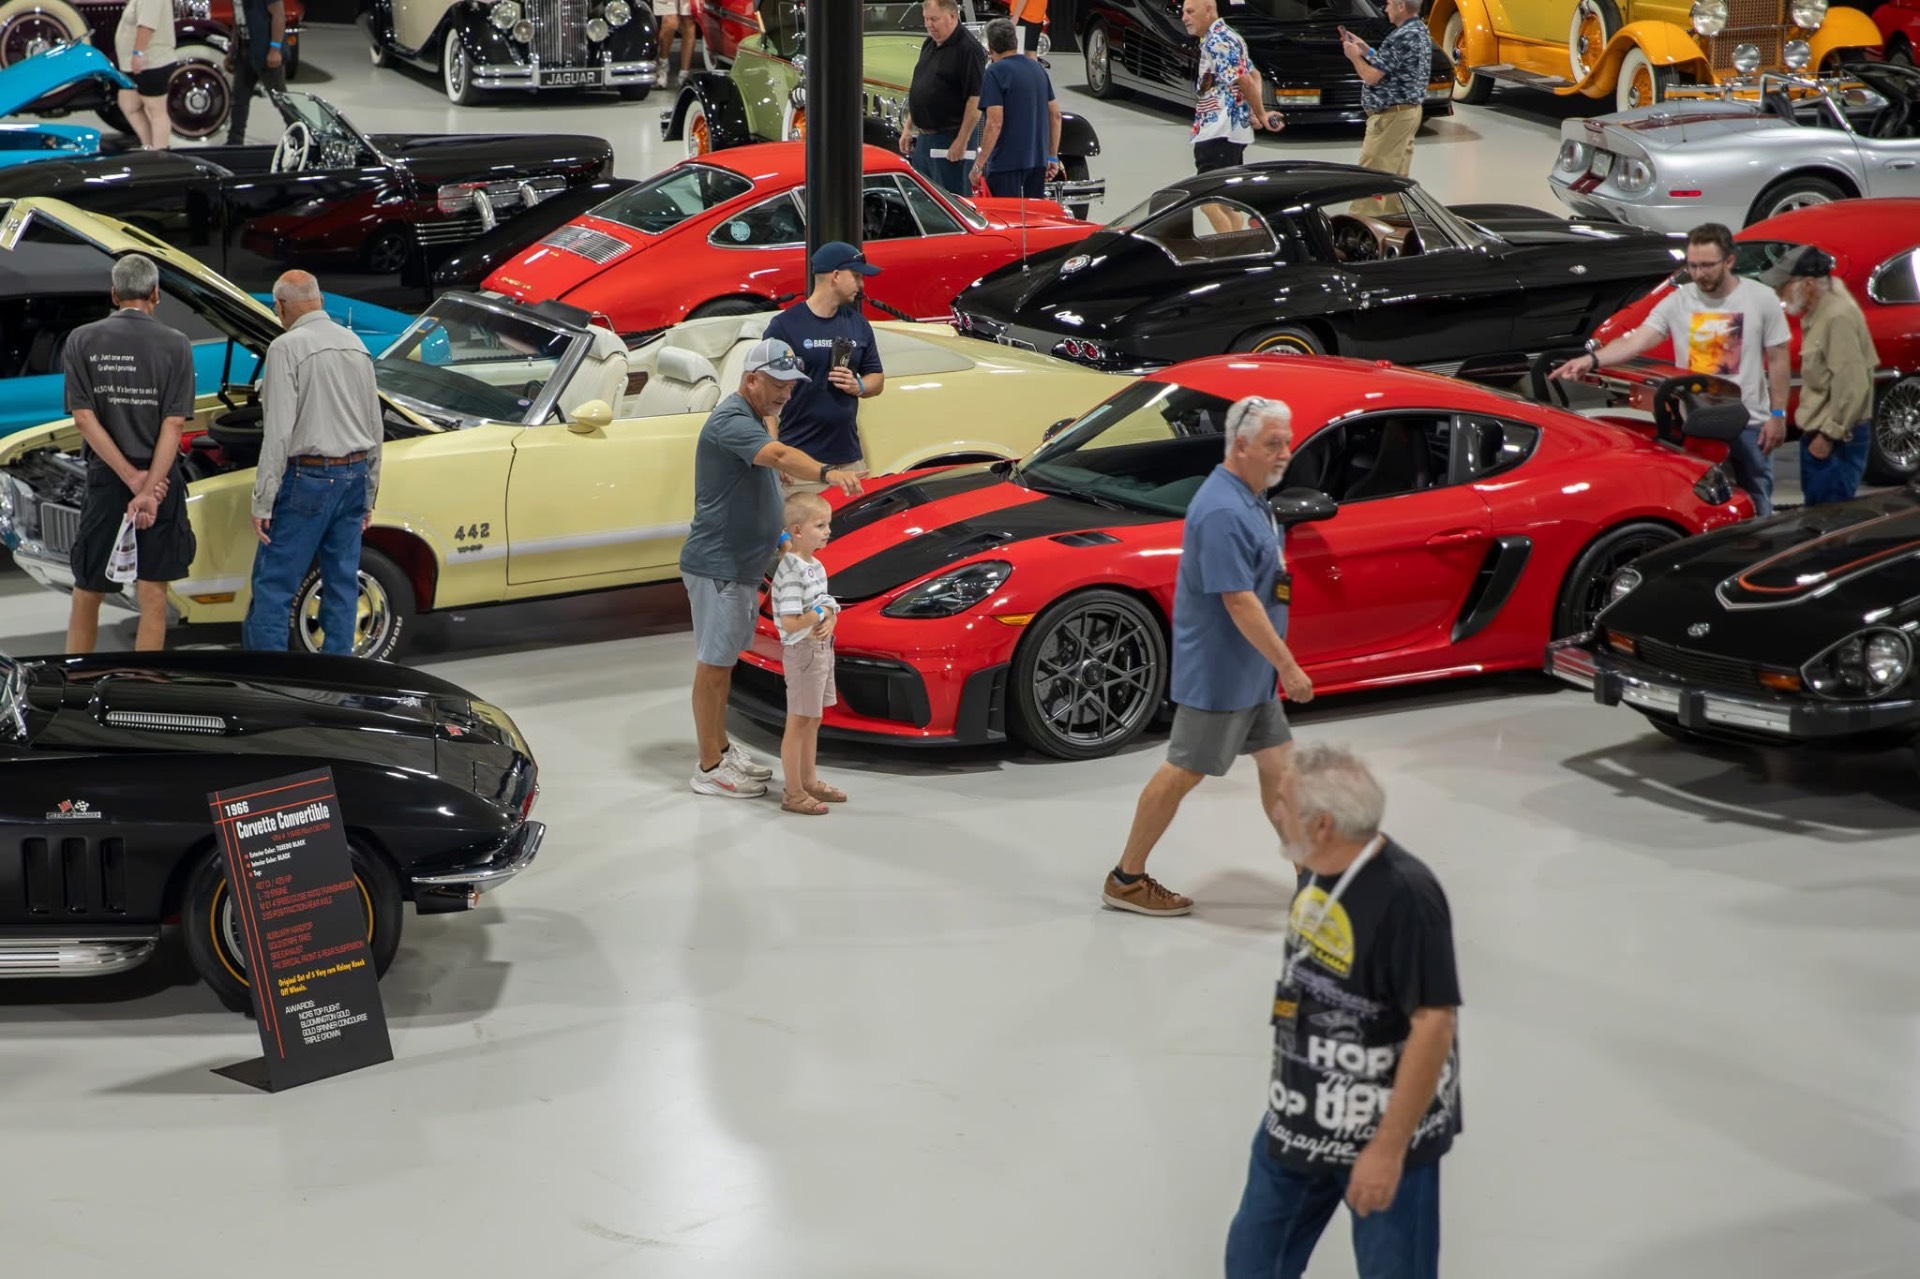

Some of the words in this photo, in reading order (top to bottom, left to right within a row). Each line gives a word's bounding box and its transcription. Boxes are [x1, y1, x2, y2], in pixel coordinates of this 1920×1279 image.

[547, 72, 595, 85] JAGUAR
[454, 522, 490, 541] 442
[225, 801, 249, 817] 1966
[236, 817, 277, 839] Corvette
[277, 803, 329, 829] Convertible
[264, 847, 276, 855] Color:
[276, 842, 292, 851] TUXEDO
[292, 839, 306, 847] BLACK
[265, 856, 277, 864] Color:
[277, 852, 291, 861] BLACK
[278, 976, 296, 987] Original
[296, 974, 305, 982] Set
[306, 971, 312, 980] of
[315, 969, 326, 977] Very
[351, 958, 365, 968] Knock
[280, 987, 289, 996] Off
[285, 1000, 315, 1014] AWARDS:
[313, 1007, 323, 1016] TOP
[323, 1003, 340, 1013] FLIGHT
[300, 1013, 337, 1028] BLOOMINGTON
[336, 1009, 350, 1019] GOLD
[302, 1027, 316, 1037] GOLD
[337, 1013, 367, 1027] CONCOURSE
[304, 1034, 321, 1044] TRIPLE
[320, 1029, 341, 1040] CROWN
[1308, 1035, 1394, 1078] HOP
[1268, 1079, 1307, 1117] OP
